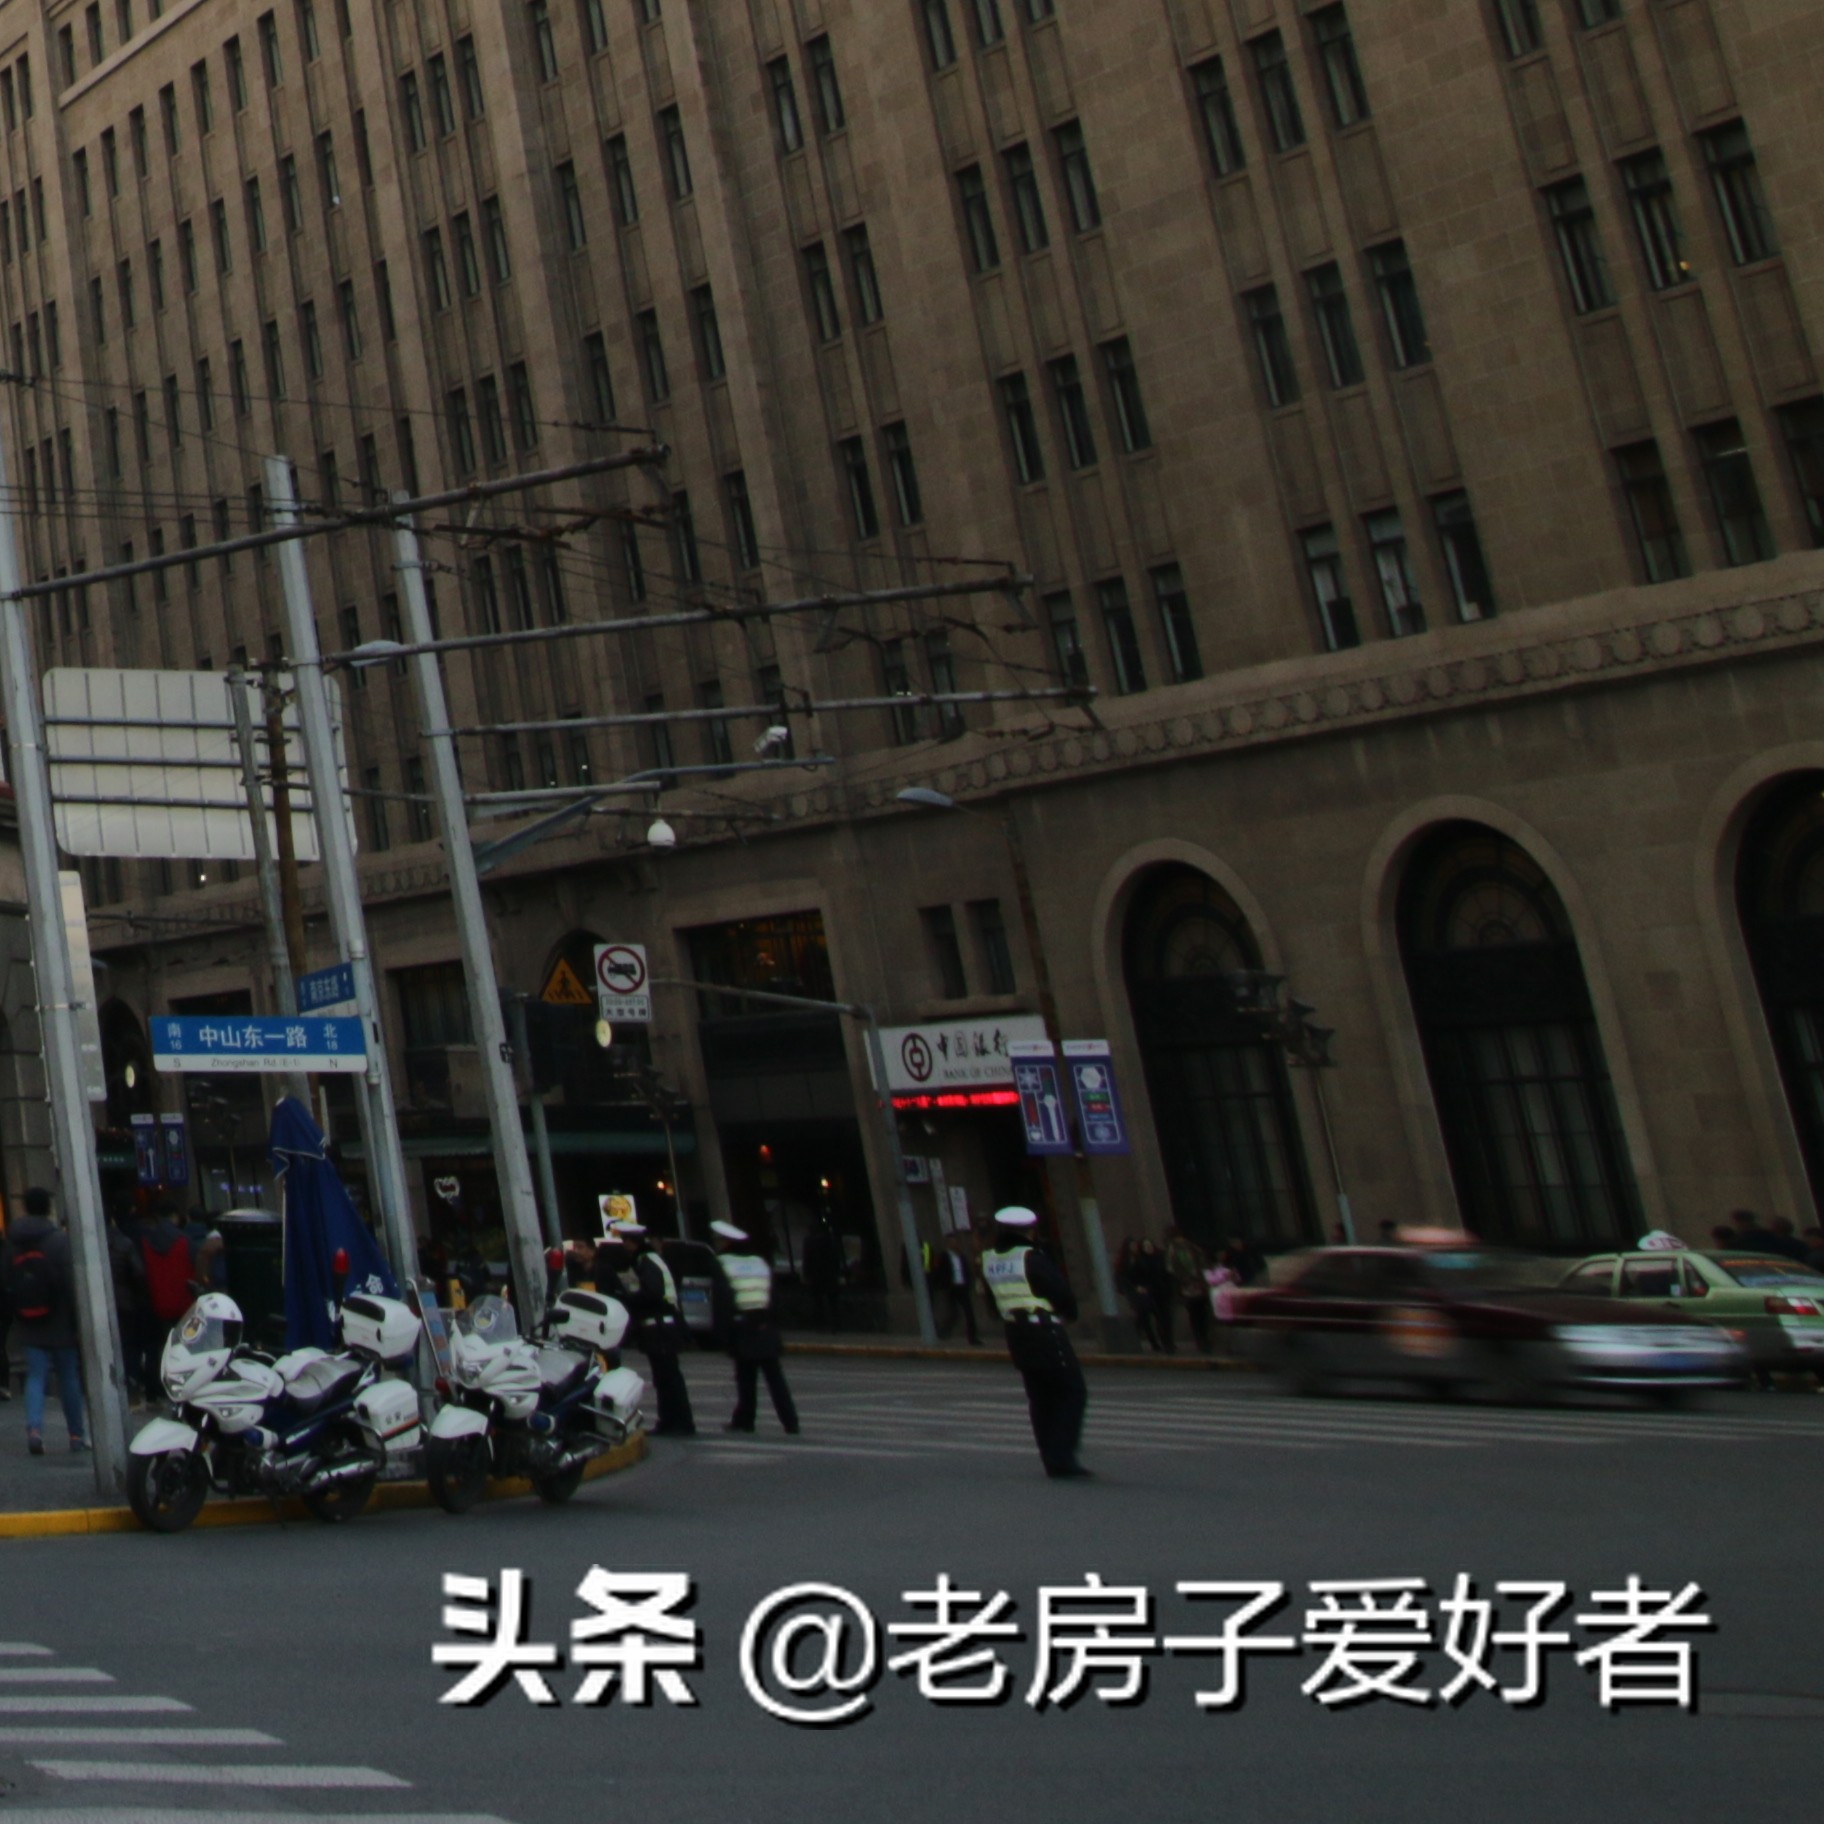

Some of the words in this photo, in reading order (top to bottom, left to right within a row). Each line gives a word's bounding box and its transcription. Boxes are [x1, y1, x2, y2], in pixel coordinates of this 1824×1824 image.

[167, 1022, 182, 1038] 南
[198, 1024, 307, 1048] 中山东一路
[323, 1023, 338, 1038] 北
[210, 1057, 260, 1069] Zhongshan
[329, 1058, 338, 1068] N
[943, 1067, 968, 1079] BANK
[984, 1064, 1013, 1077] CHIN
